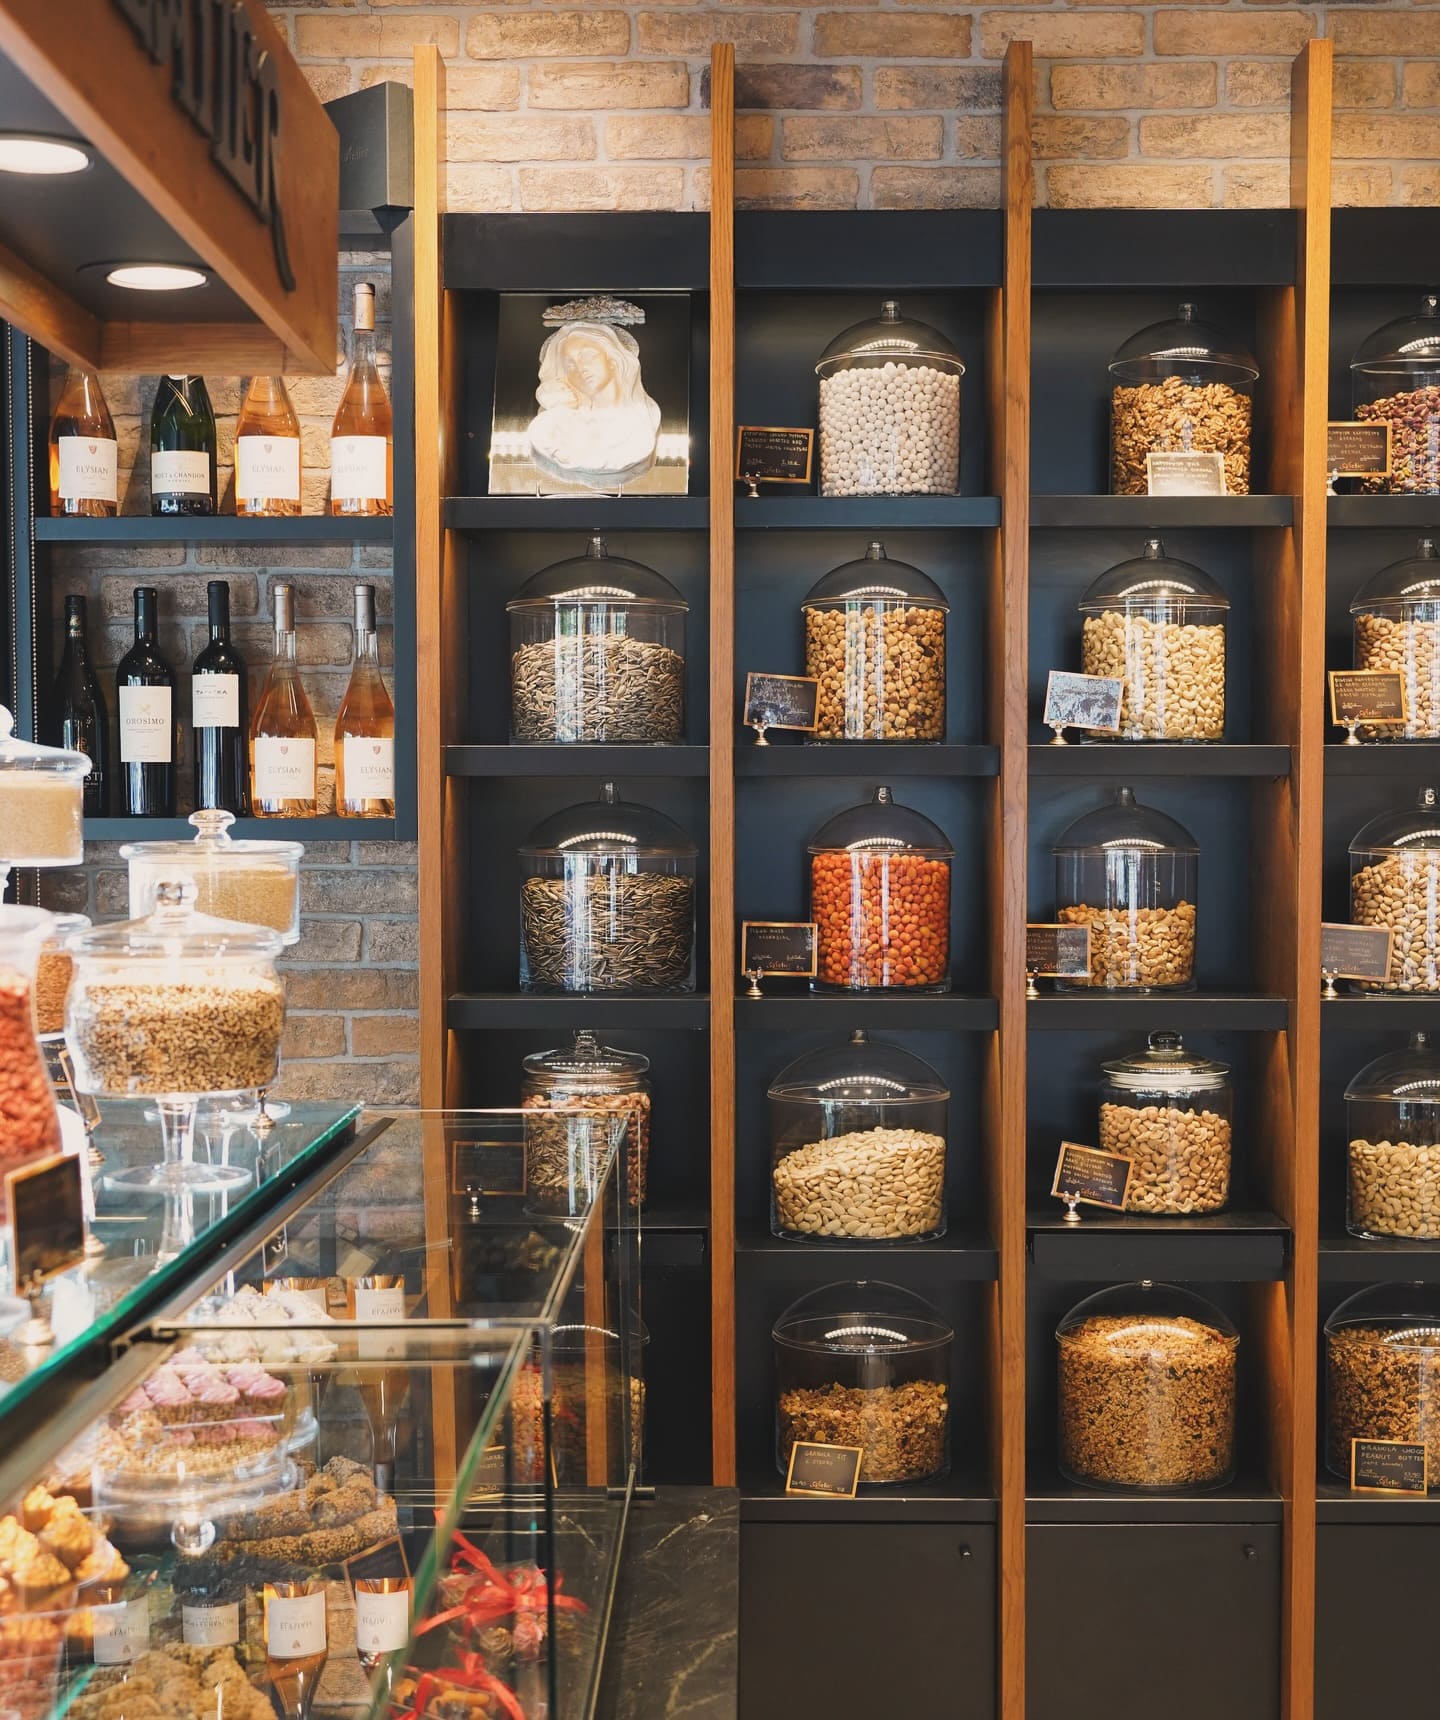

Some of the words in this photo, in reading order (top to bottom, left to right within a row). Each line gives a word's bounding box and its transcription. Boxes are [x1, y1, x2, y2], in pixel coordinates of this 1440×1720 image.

[75, 464, 108, 475] ELYSIAN
[268, 766, 301, 775] ELYSIAN
[1361, 1452, 1391, 1460] PEANUT
